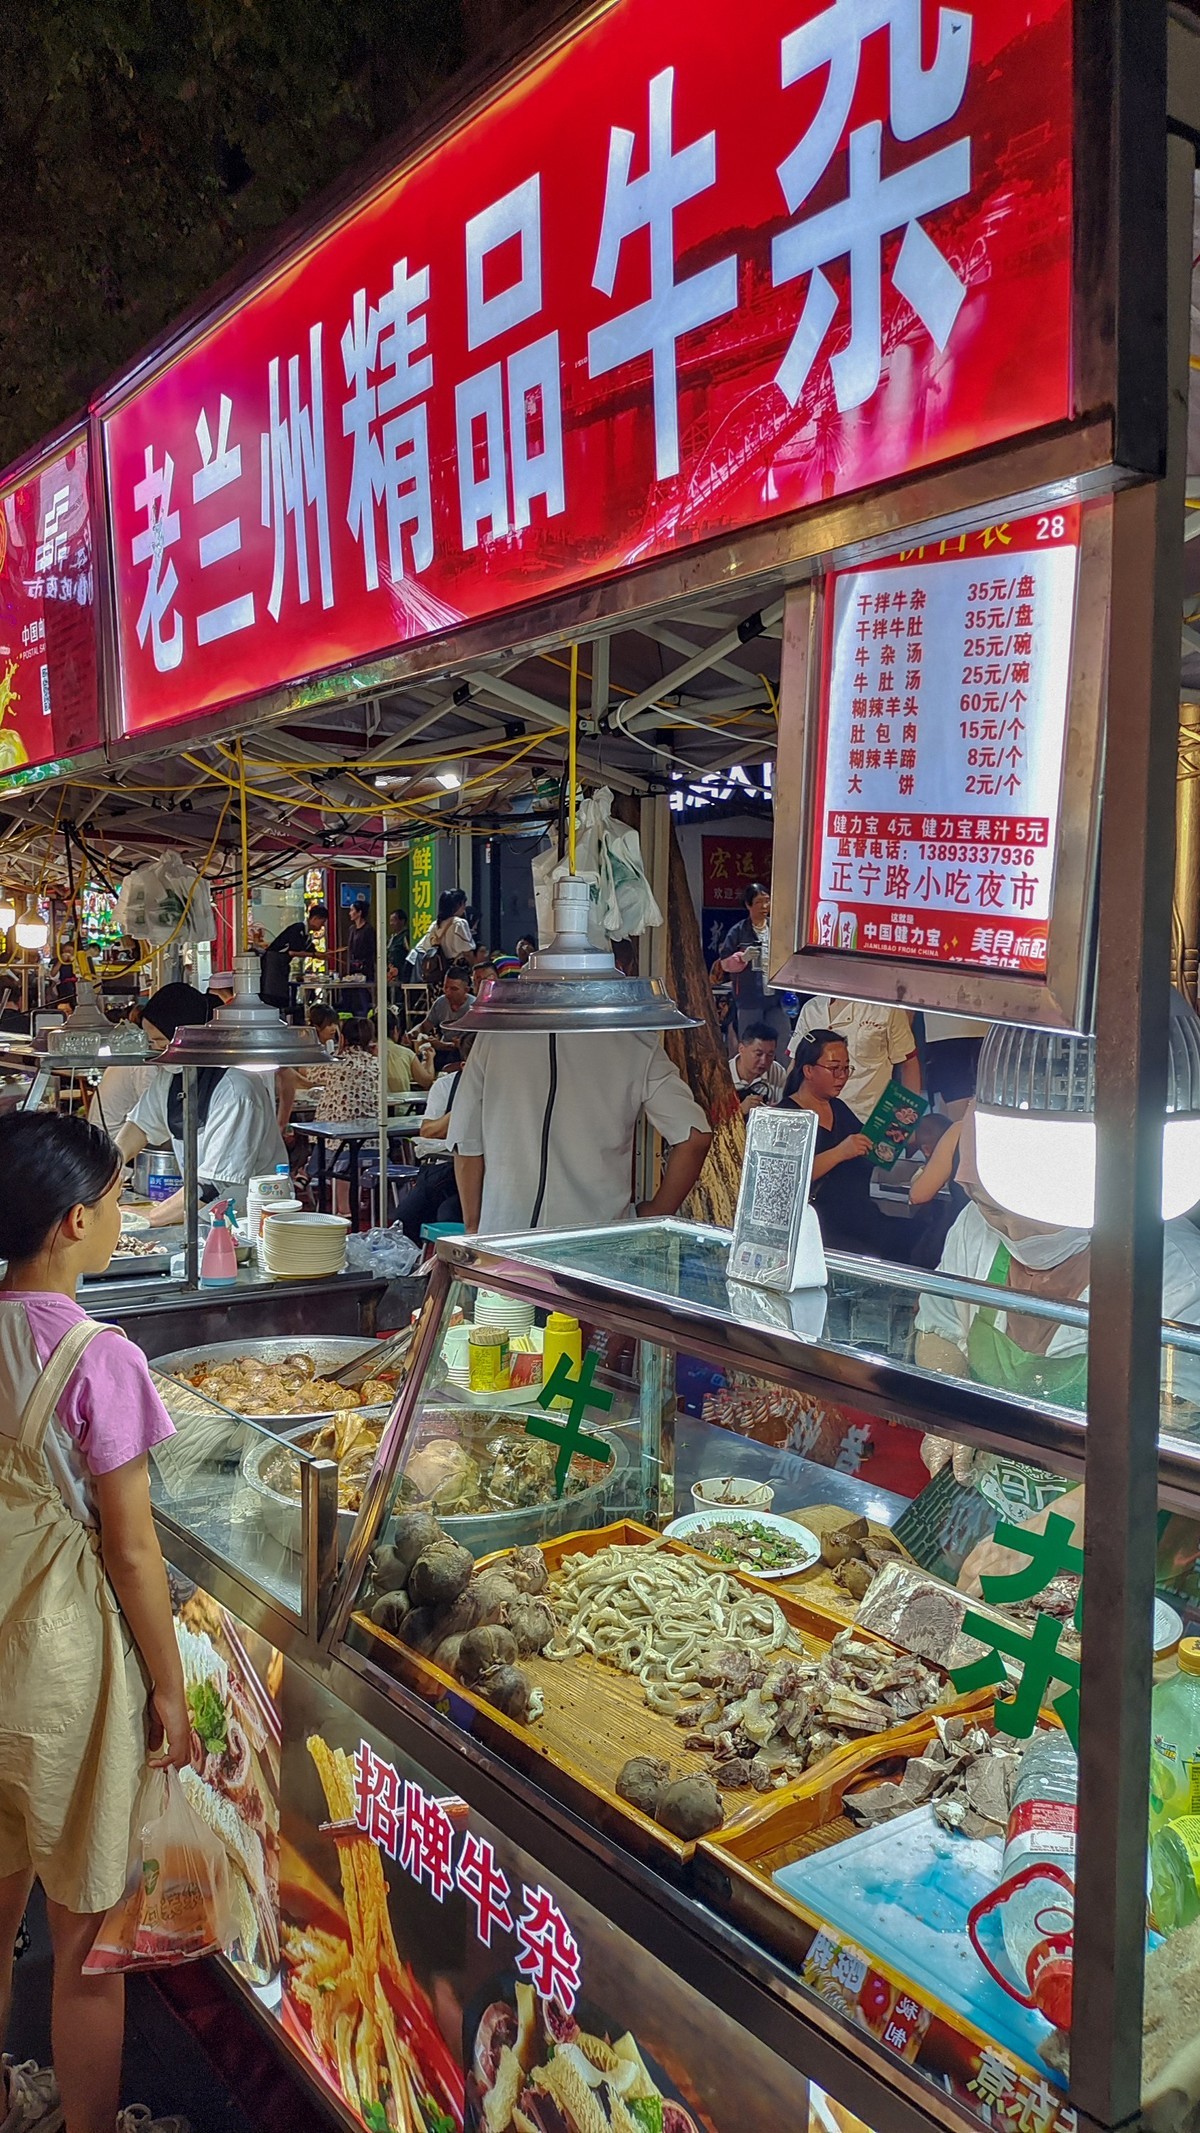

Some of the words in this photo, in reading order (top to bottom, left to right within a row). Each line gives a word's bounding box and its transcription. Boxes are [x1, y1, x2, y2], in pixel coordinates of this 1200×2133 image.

[131, 0, 972, 672] 老兰州精品牛杂
[1036, 515, 1064, 540] 28
[856, 588, 927, 616] 干拌牛杂
[967, 574, 1035, 601] 35元/盘
[855, 616, 923, 641] 干拌牛肚
[964, 603, 1033, 629] 35元/盘
[22, 648, 39, 661] POSTAL
[855, 642, 923, 667] 牛杂汤
[963, 632, 1031, 657] 25元/碗
[853, 669, 921, 693] 牛肚汤
[961, 660, 1030, 685] 25元/碗
[851, 695, 919, 718] 糊辣羊头
[960, 689, 1027, 713] 60元/个
[850, 721, 917, 744] 肚包肉
[960, 717, 1025, 741] 15元/个
[849, 749, 917, 769] 糊辣羊蹄
[967, 748, 1023, 767] 8元/个
[847, 774, 914, 795] 大饼
[965, 774, 1021, 796] 2元/个
[833, 814, 879, 836] 健力宝
[887, 818, 912, 837] 4元
[921, 818, 1010, 841] 健力宝果汁
[1015, 824, 1044, 842] 5元
[918, 843, 1035, 866] 13893337936
[412, 834, 433, 940] 鲜切烤
[828, 861, 1039, 911] 正宁路小吃夜市
[891, 912, 914, 924] 这就是
[864, 922, 941, 947] 中国健力宝
[970, 927, 1047, 959] 美食标配
[864, 942, 896, 952] JIANLIBAO
[898, 946, 916, 954] FROM
[918, 948, 939, 957] CHINA
[525, 1350, 615, 1500] 牛
[352, 1738, 581, 2014] 招牌牛杂
